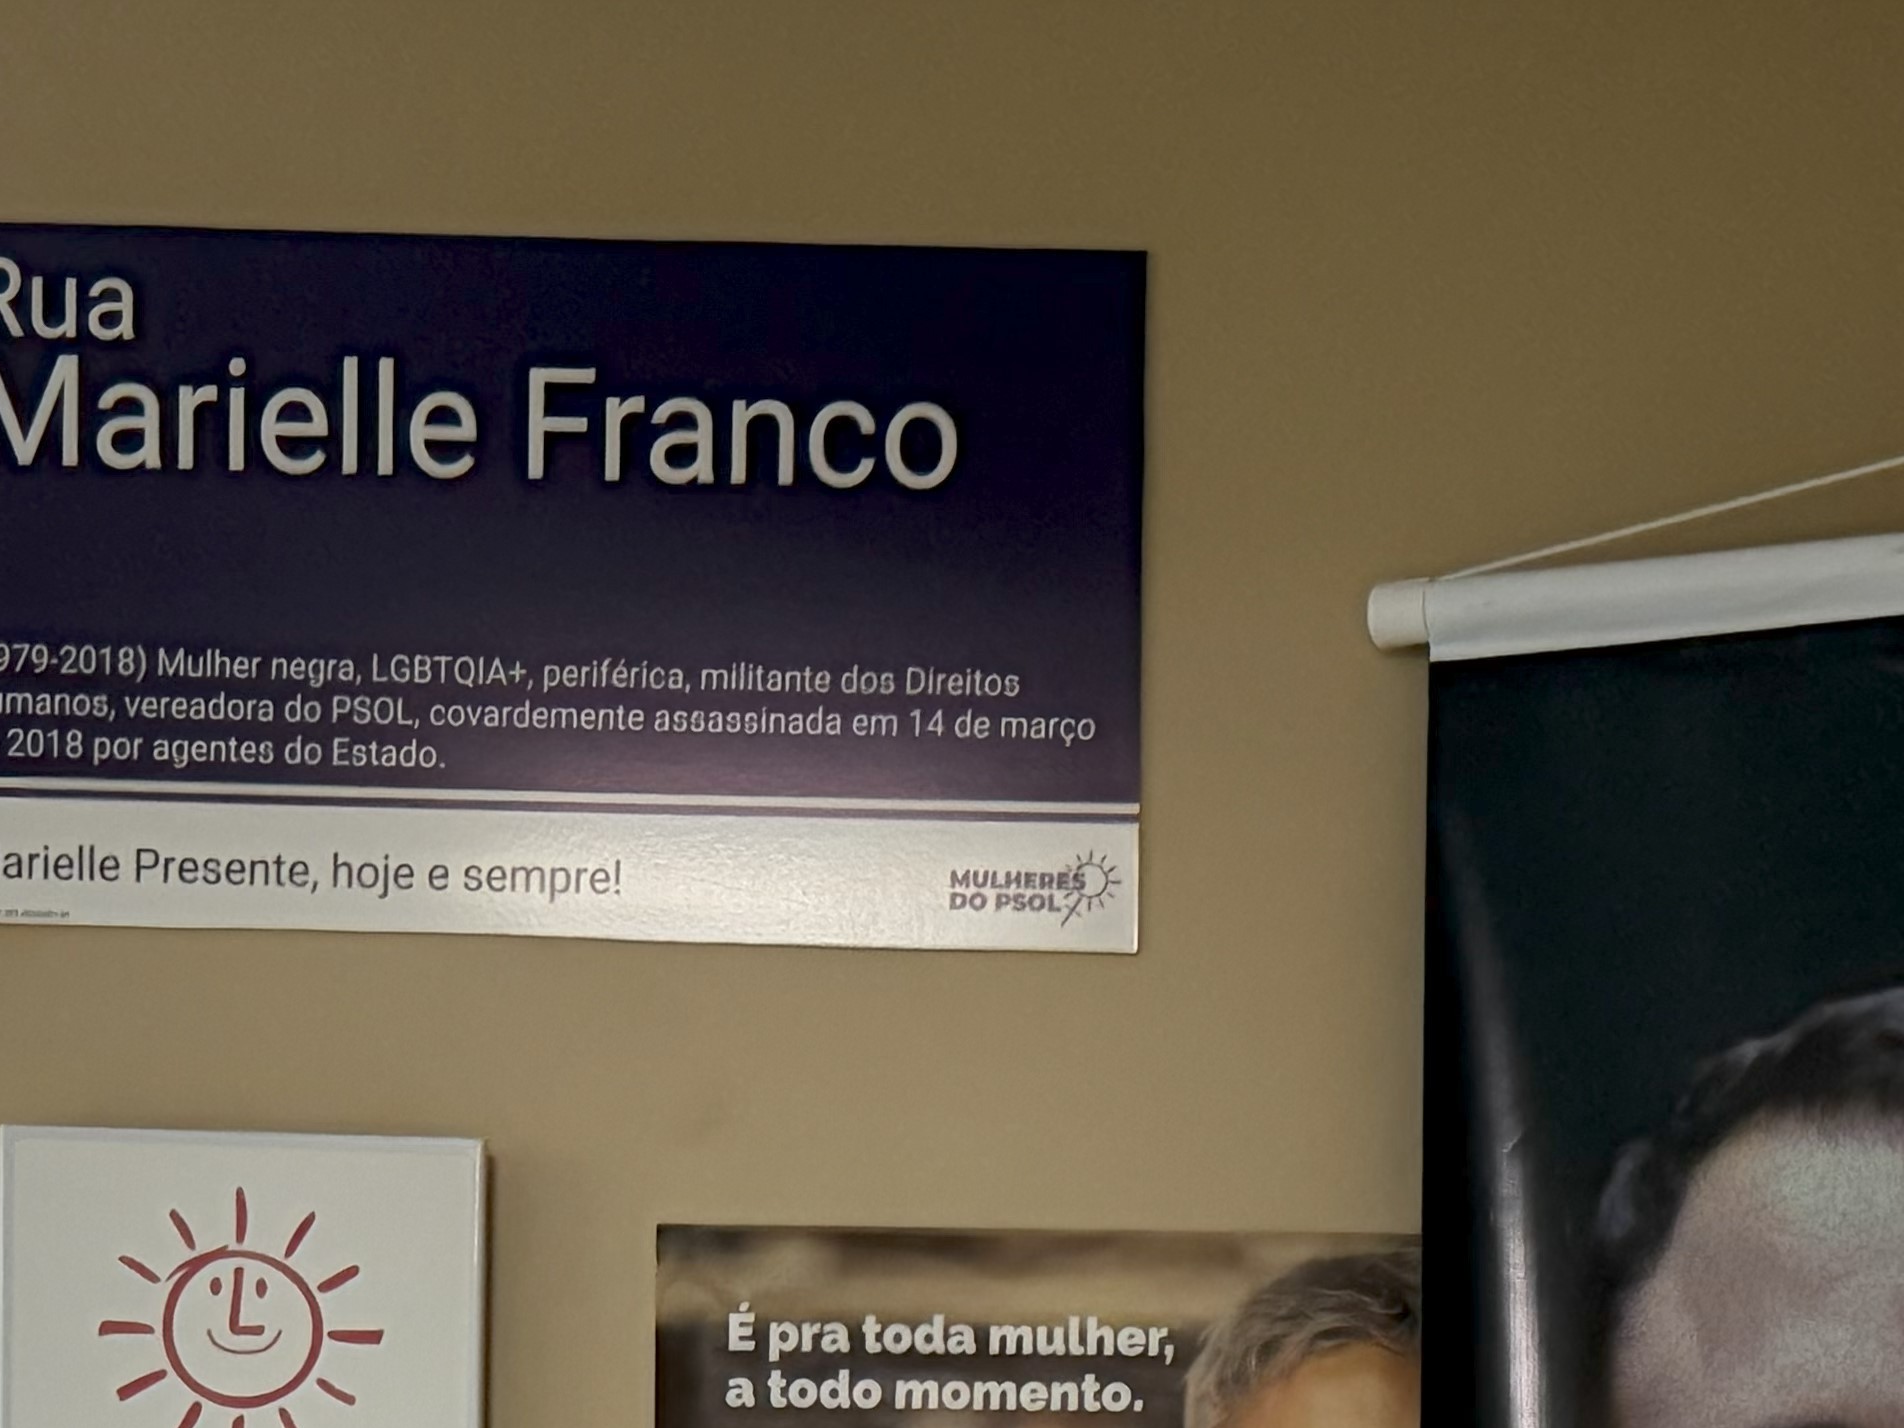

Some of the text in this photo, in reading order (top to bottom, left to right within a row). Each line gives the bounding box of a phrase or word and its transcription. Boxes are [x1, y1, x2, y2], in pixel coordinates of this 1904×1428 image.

[526, 366, 960, 490] Franco
[158, 648, 259, 680] Mulher
[271, 654, 362, 688] negra,
[372, 655, 534, 690] LGBTQIA+,
[543, 660, 692, 695] periférica,
[700, 666, 831, 694] militante
[841, 665, 895, 695] dos
[905, 668, 1020, 696] Direitos
[125, 693, 274, 722] vereadora
[284, 694, 322, 724] do
[332, 697, 420, 728] PSOL,
[429, 701, 645, 733] covardemente
[654, 707, 841, 736] assassinada
[852, 713, 897, 736] em
[910, 709, 943, 737] 14
[955, 708, 991, 738] de
[1000, 715, 1095, 746] março
[7, 730, 83, 758] 2018
[94, 736, 142, 766] por
[153, 736, 273, 767] agentes
[284, 737, 322, 764] do
[332, 737, 447, 768] Estado.
[135, 848, 320, 892] Presente,
[332, 853, 415, 898] hoje
[428, 864, 449, 891] e
[463, 860, 622, 902] sempre!
[950, 869, 1086, 890] MULHERES
[949, 893, 1061, 912] DO PSOL
[727, 1301, 1175, 1365] É pra toda mulher,
[725, 1369, 1144, 1413] a todo momento.
